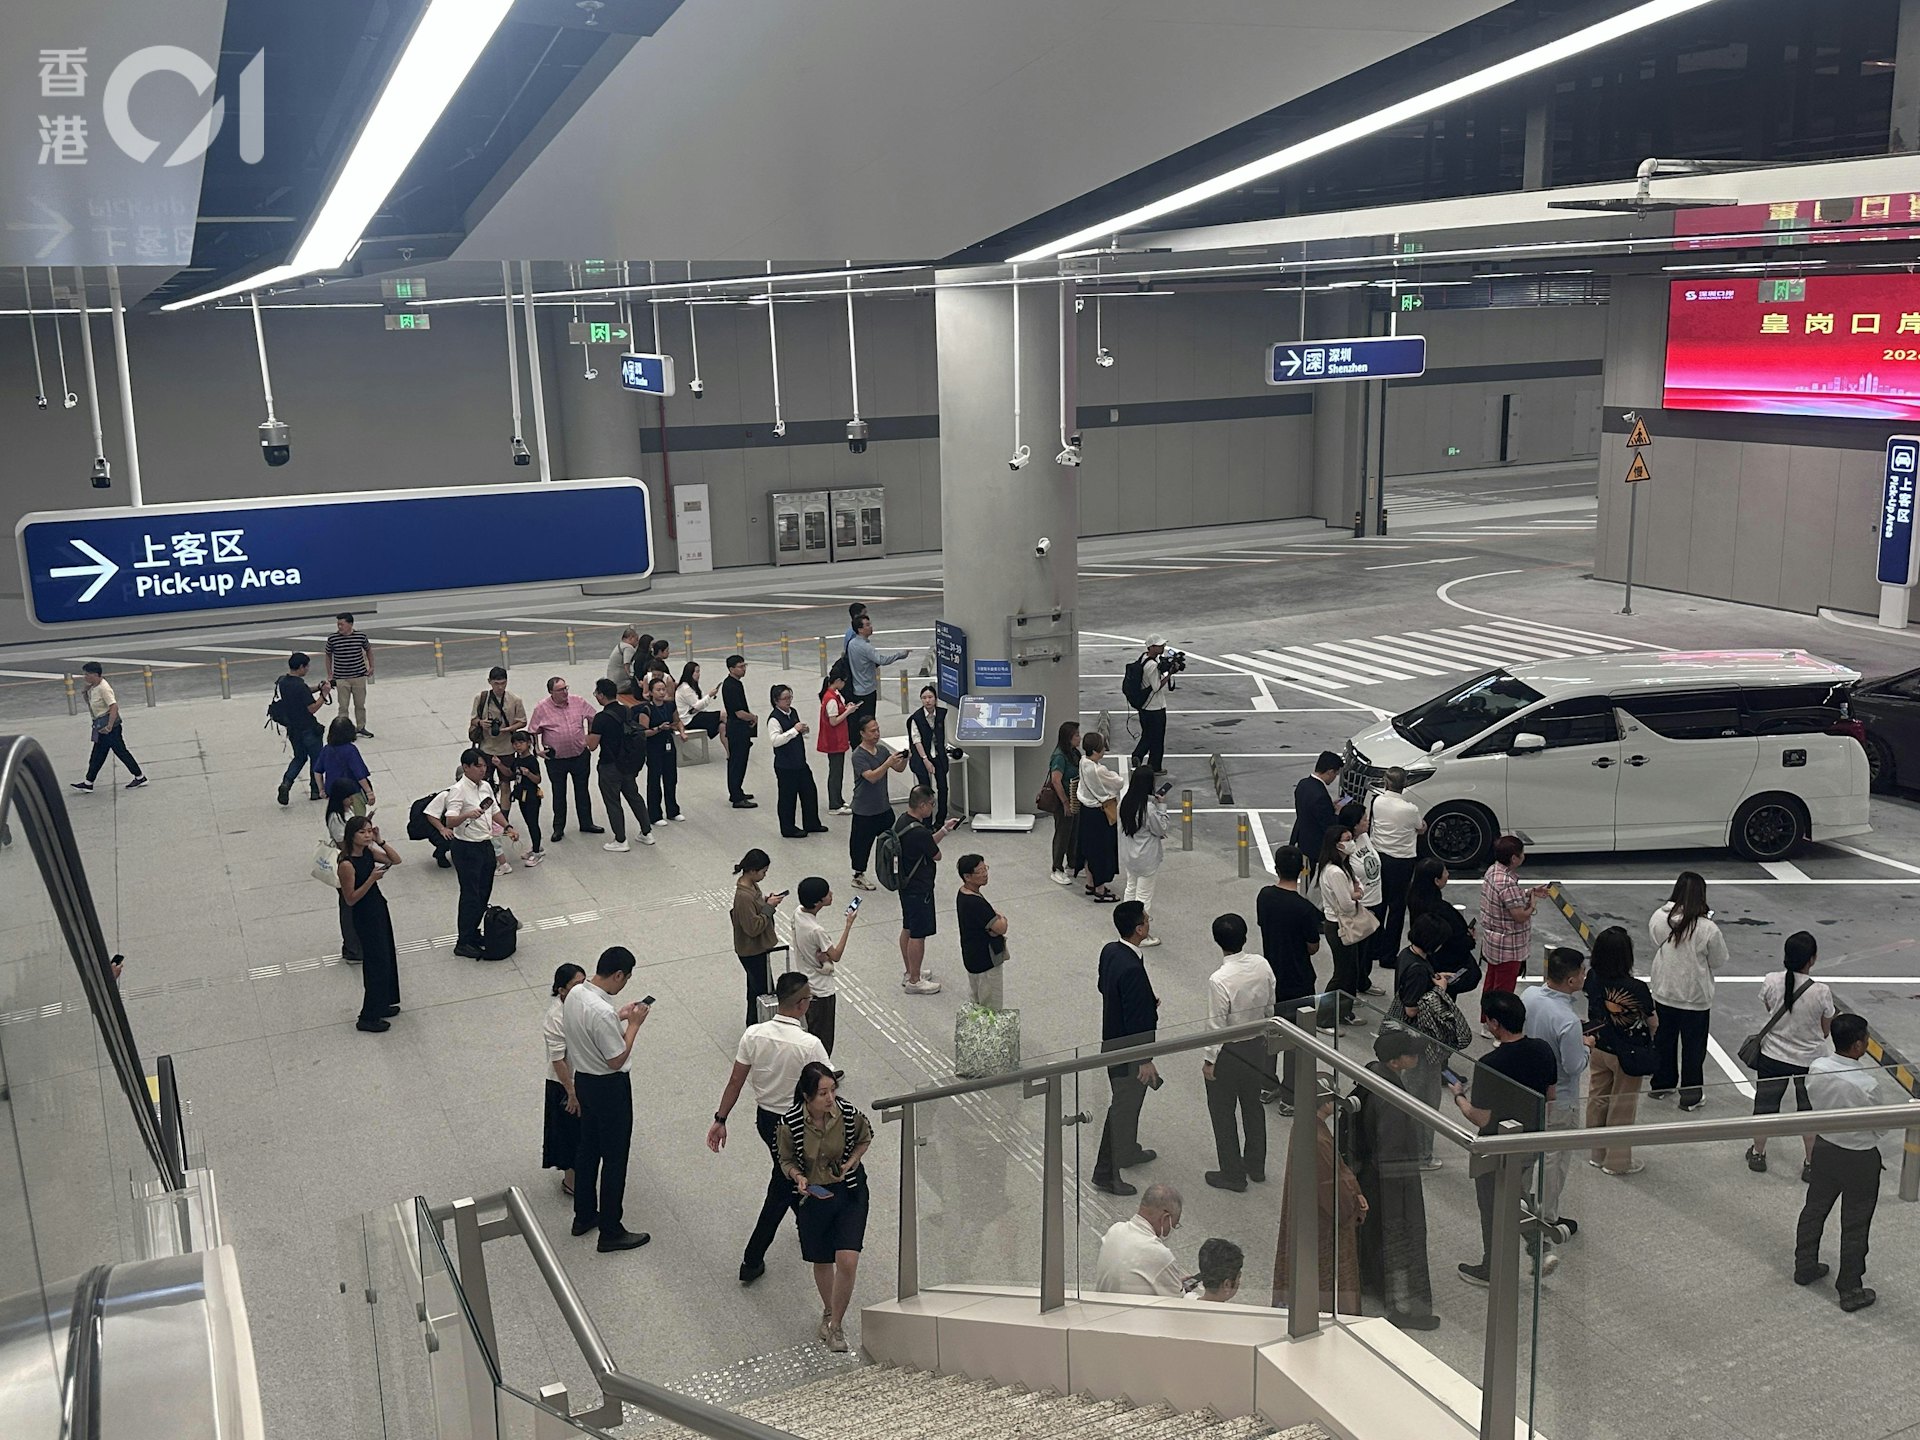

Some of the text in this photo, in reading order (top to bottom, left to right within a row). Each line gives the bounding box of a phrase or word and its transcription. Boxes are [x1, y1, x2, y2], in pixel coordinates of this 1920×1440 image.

[1760, 312, 1920, 334] 皇岗口岸
[1306, 352, 1322, 371] 深
[1328, 347, 1352, 362] 深圳
[1883, 349, 1920, 361] 202
[1328, 363, 1368, 374] Shenzhen
[1897, 476, 1912, 523] 上客区
[1885, 513, 1896, 538] Area
[133, 529, 248, 569] 上客区
[136, 567, 301, 598] Pick-up Area
